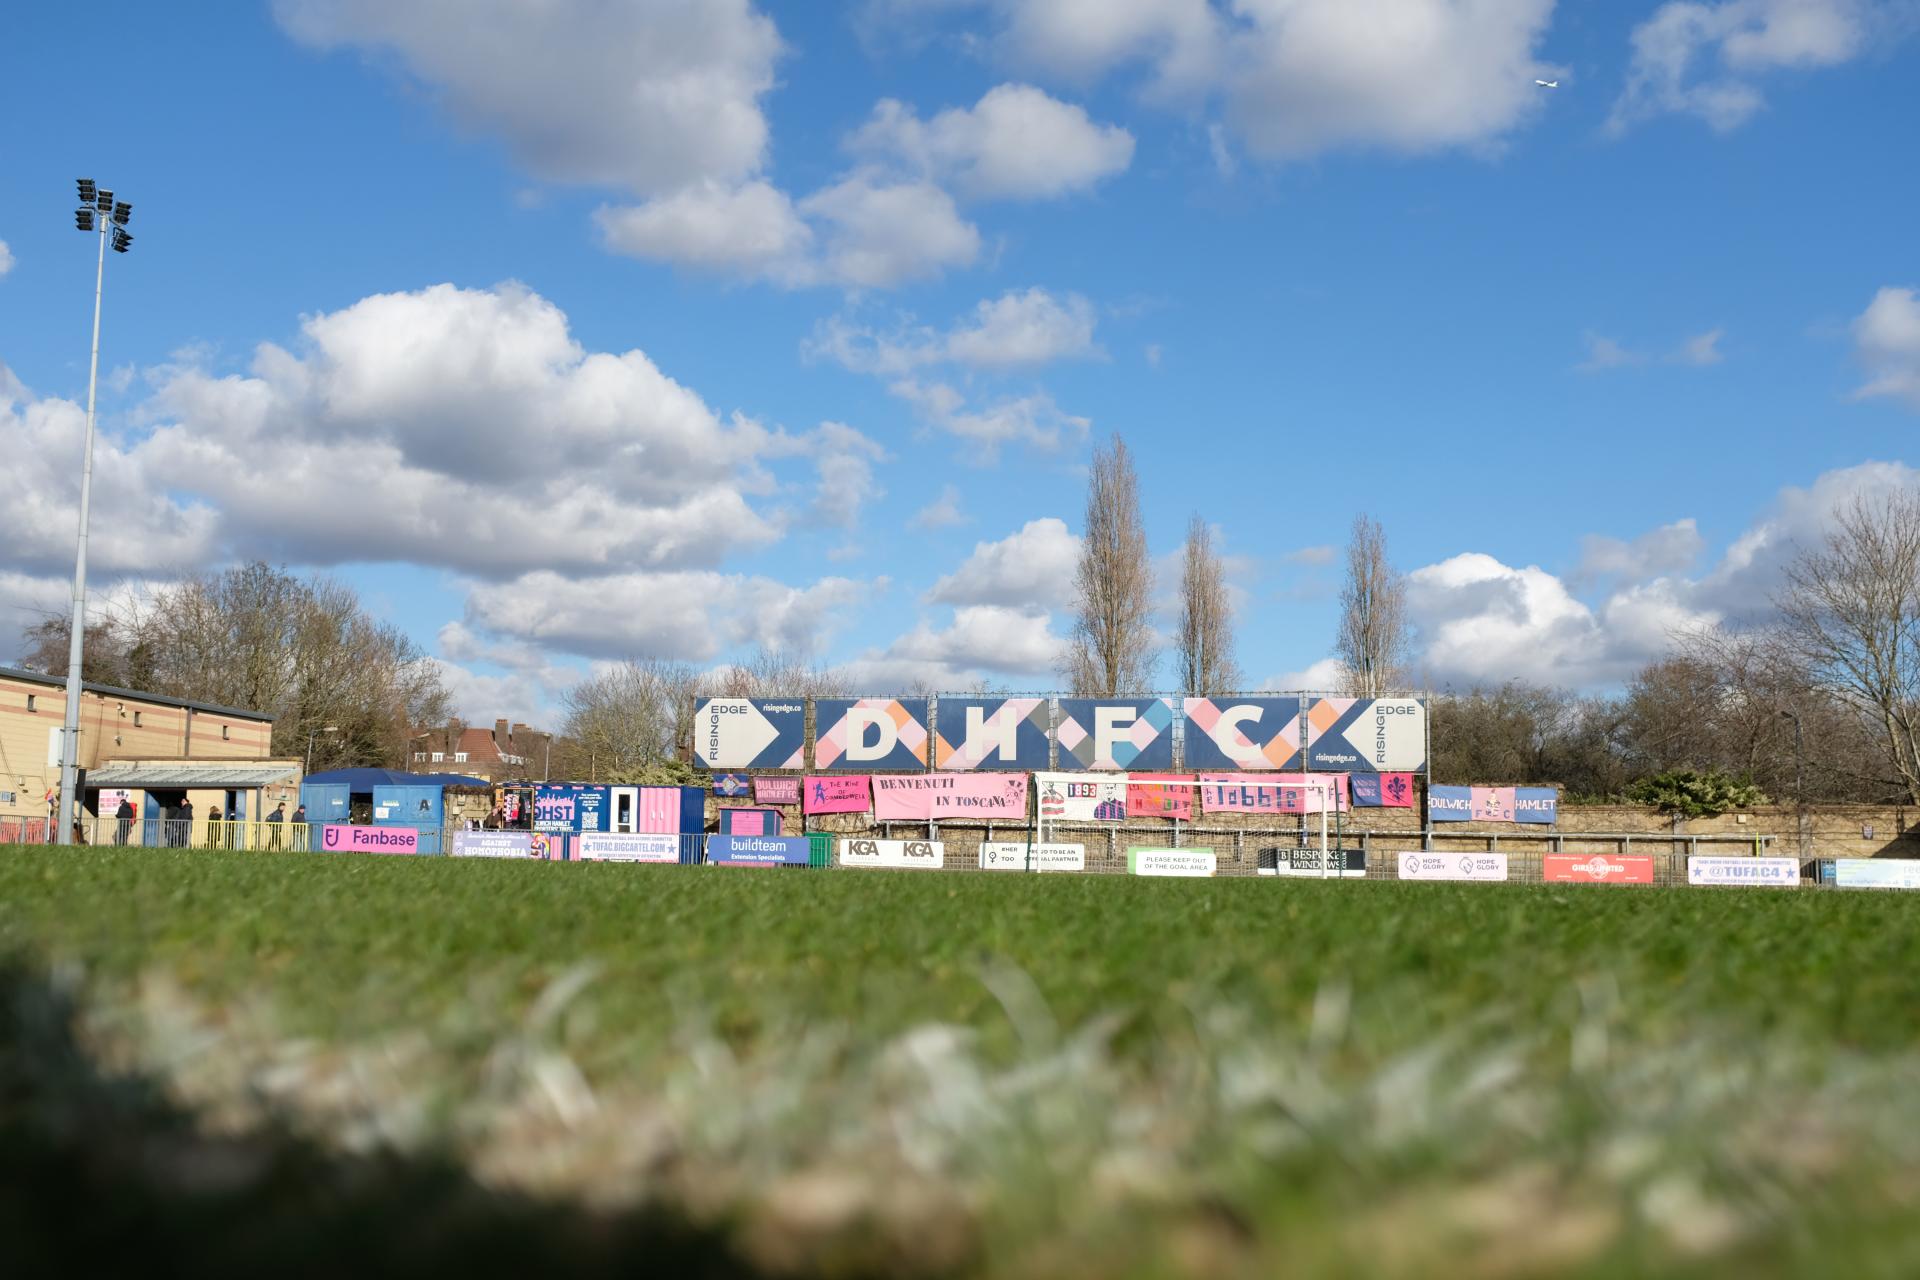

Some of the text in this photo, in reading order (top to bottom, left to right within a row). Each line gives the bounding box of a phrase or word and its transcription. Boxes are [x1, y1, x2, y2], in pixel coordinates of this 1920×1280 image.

[711, 705, 747, 714] EDGE
[763, 704, 801, 713] risingedge.co
[1377, 706, 1415, 715] EDGE
[710, 715, 719, 760] RISING
[1377, 715, 1386, 763] RISING
[1316, 754, 1356, 763] risingedge.co
[755, 780, 798, 790] DULWICH
[880, 777, 954, 790] BENVENUTI
[1068, 783, 1097, 798] 1893
[936, 795, 1006, 807] IN TOSCANA
[1430, 798, 1471, 810] DULWICH
[1515, 799, 1555, 811] HAMLET
[353, 830, 415, 845] Fanbase
[732, 838, 786, 852] buildteam
[848, 841, 879, 856] KGA
[903, 842, 934, 857] KGA
[464, 847, 527, 857] HOMOPHOBIA
[1709, 866, 1780, 878] @TUFAC4
